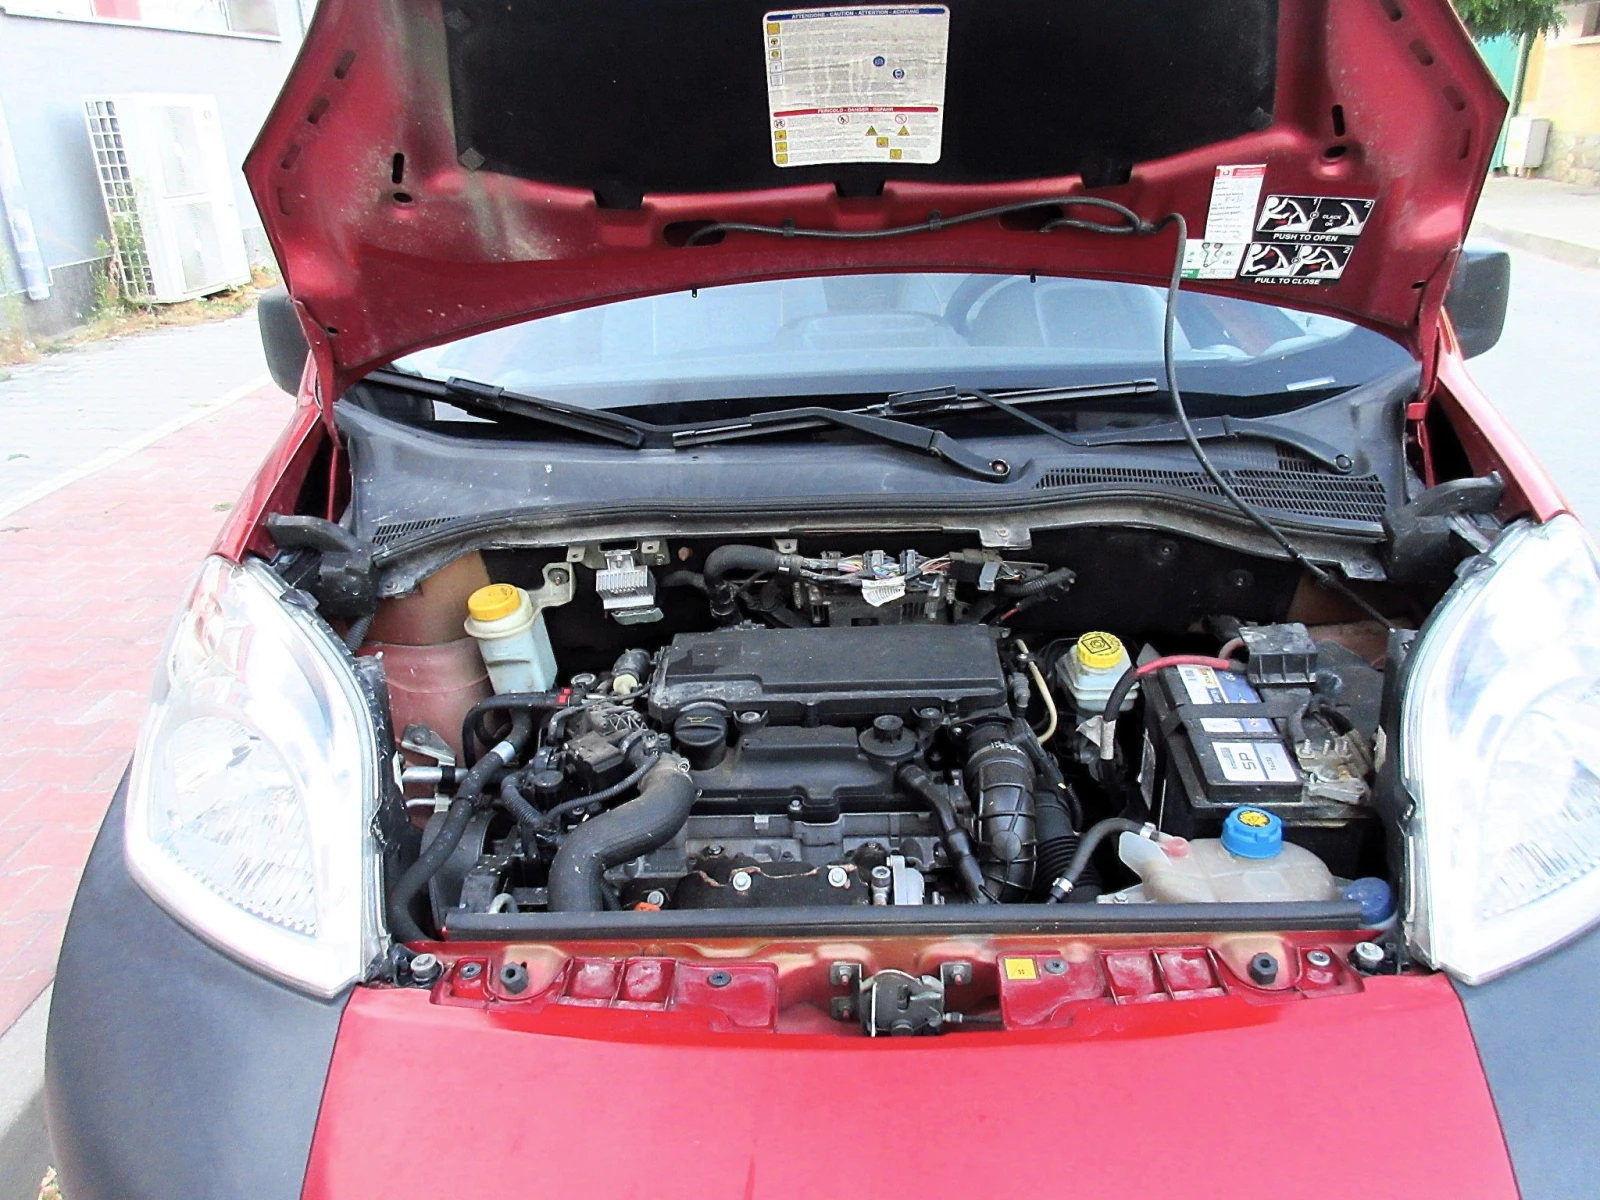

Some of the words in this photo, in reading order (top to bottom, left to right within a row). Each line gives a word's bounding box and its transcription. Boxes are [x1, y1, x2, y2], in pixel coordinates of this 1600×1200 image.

[1363, 201, 1372, 209] 2
[1300, 233, 1311, 241] TO
[1312, 234, 1339, 242] OPEN
[1294, 244, 1299, 252] 1
[1342, 246, 1351, 254] 2
